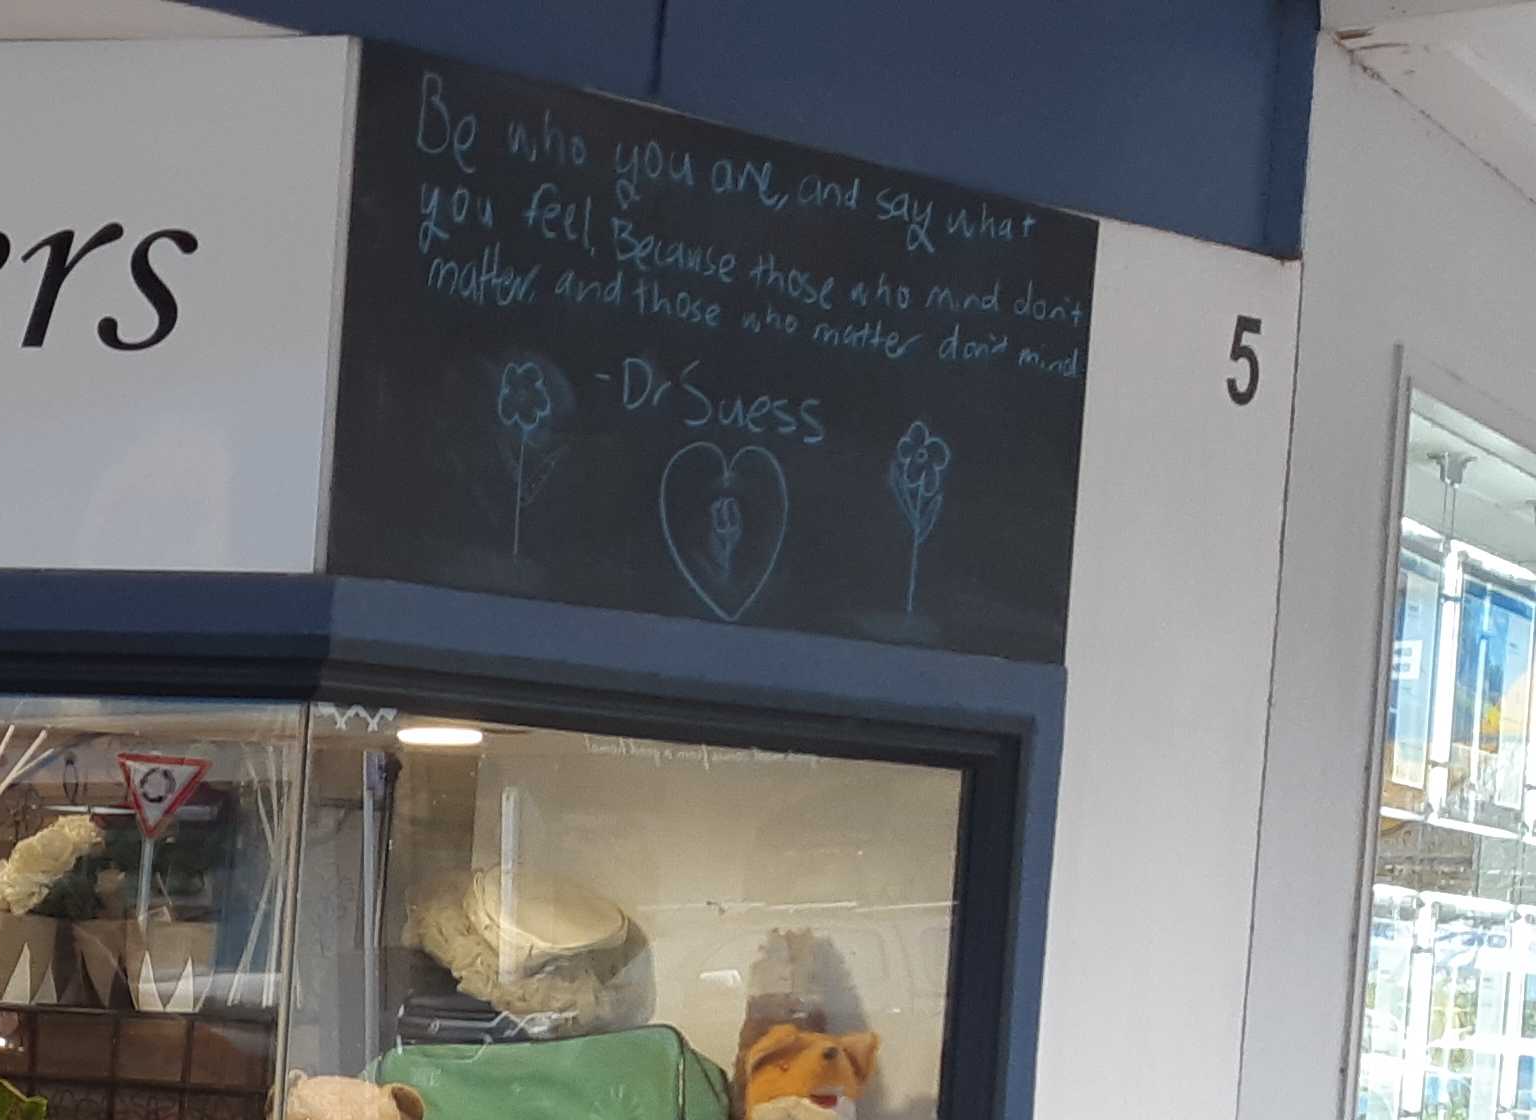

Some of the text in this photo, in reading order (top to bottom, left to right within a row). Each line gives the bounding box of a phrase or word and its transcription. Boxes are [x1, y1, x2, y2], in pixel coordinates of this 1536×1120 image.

[417, 73, 476, 174] Be
[508, 108, 586, 167] who
[614, 140, 695, 210] you
[798, 174, 862, 210] and
[875, 186, 935, 253] say
[946, 202, 1037, 240] what
[419, 183, 494, 254] you
[611, 216, 737, 284] Because
[749, 253, 837, 310] those
[850, 272, 912, 310] who
[925, 279, 1002, 313] mind
[554, 270, 624, 302] and
[632, 278, 722, 327] those
[741, 304, 799, 334] who
[812, 319, 923, 359] matter
[1226, 314, 1263, 406] 5
[681, 359, 825, 444] Suess
